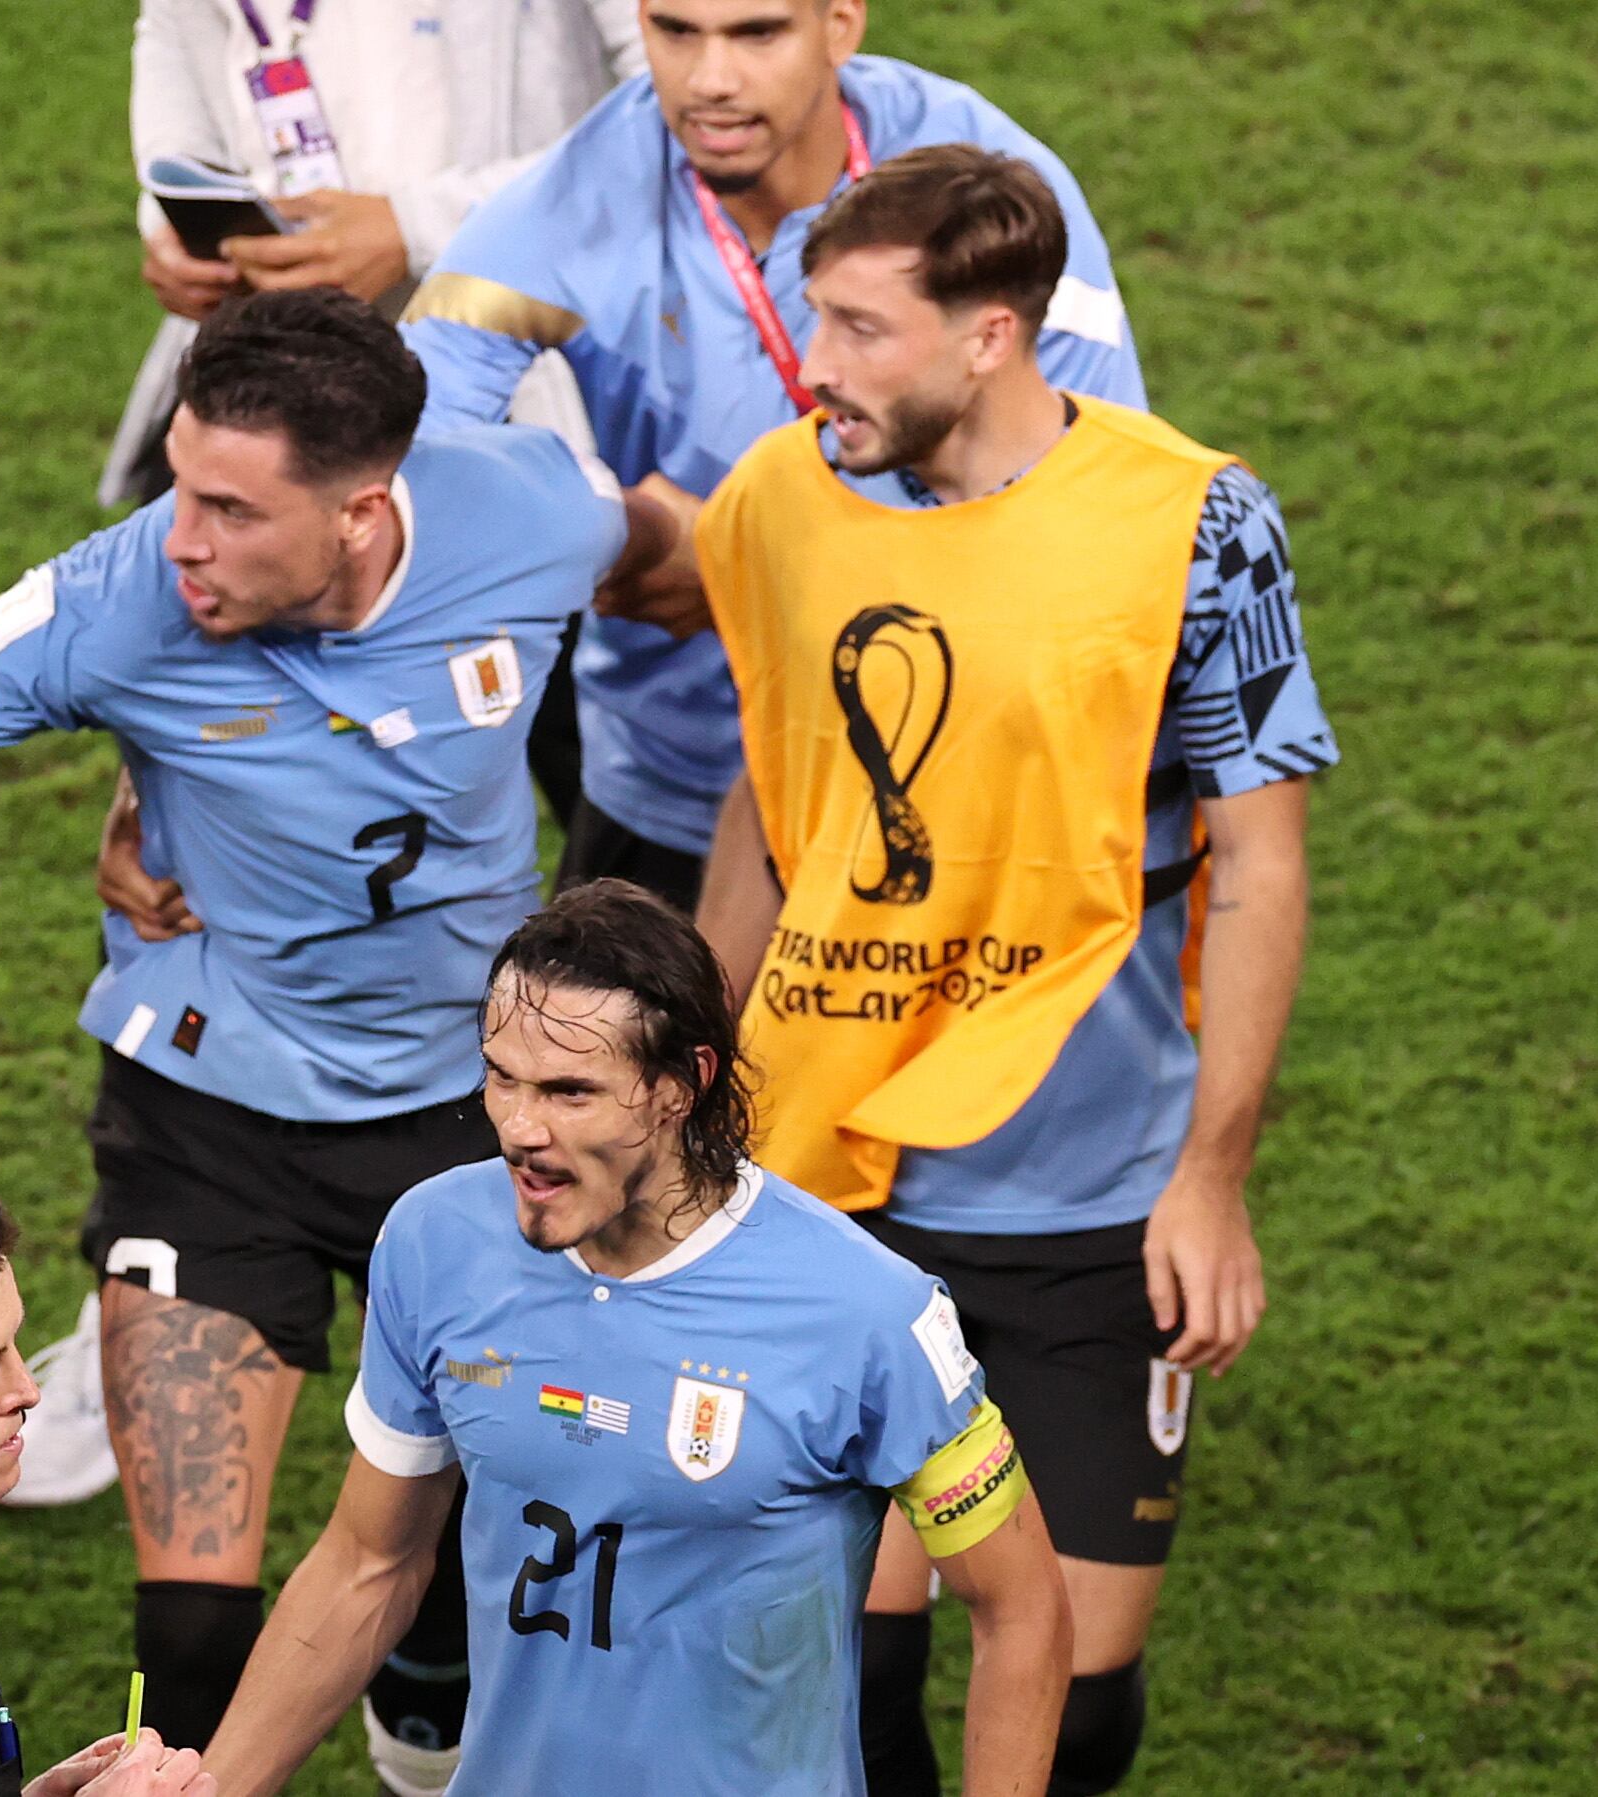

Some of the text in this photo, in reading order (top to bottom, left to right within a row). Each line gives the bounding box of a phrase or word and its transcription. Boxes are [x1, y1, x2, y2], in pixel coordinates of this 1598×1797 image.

[819, 939, 969, 974] WORLD
[978, 936, 1044, 975] CUP
[508, 1499, 624, 1652] 21
